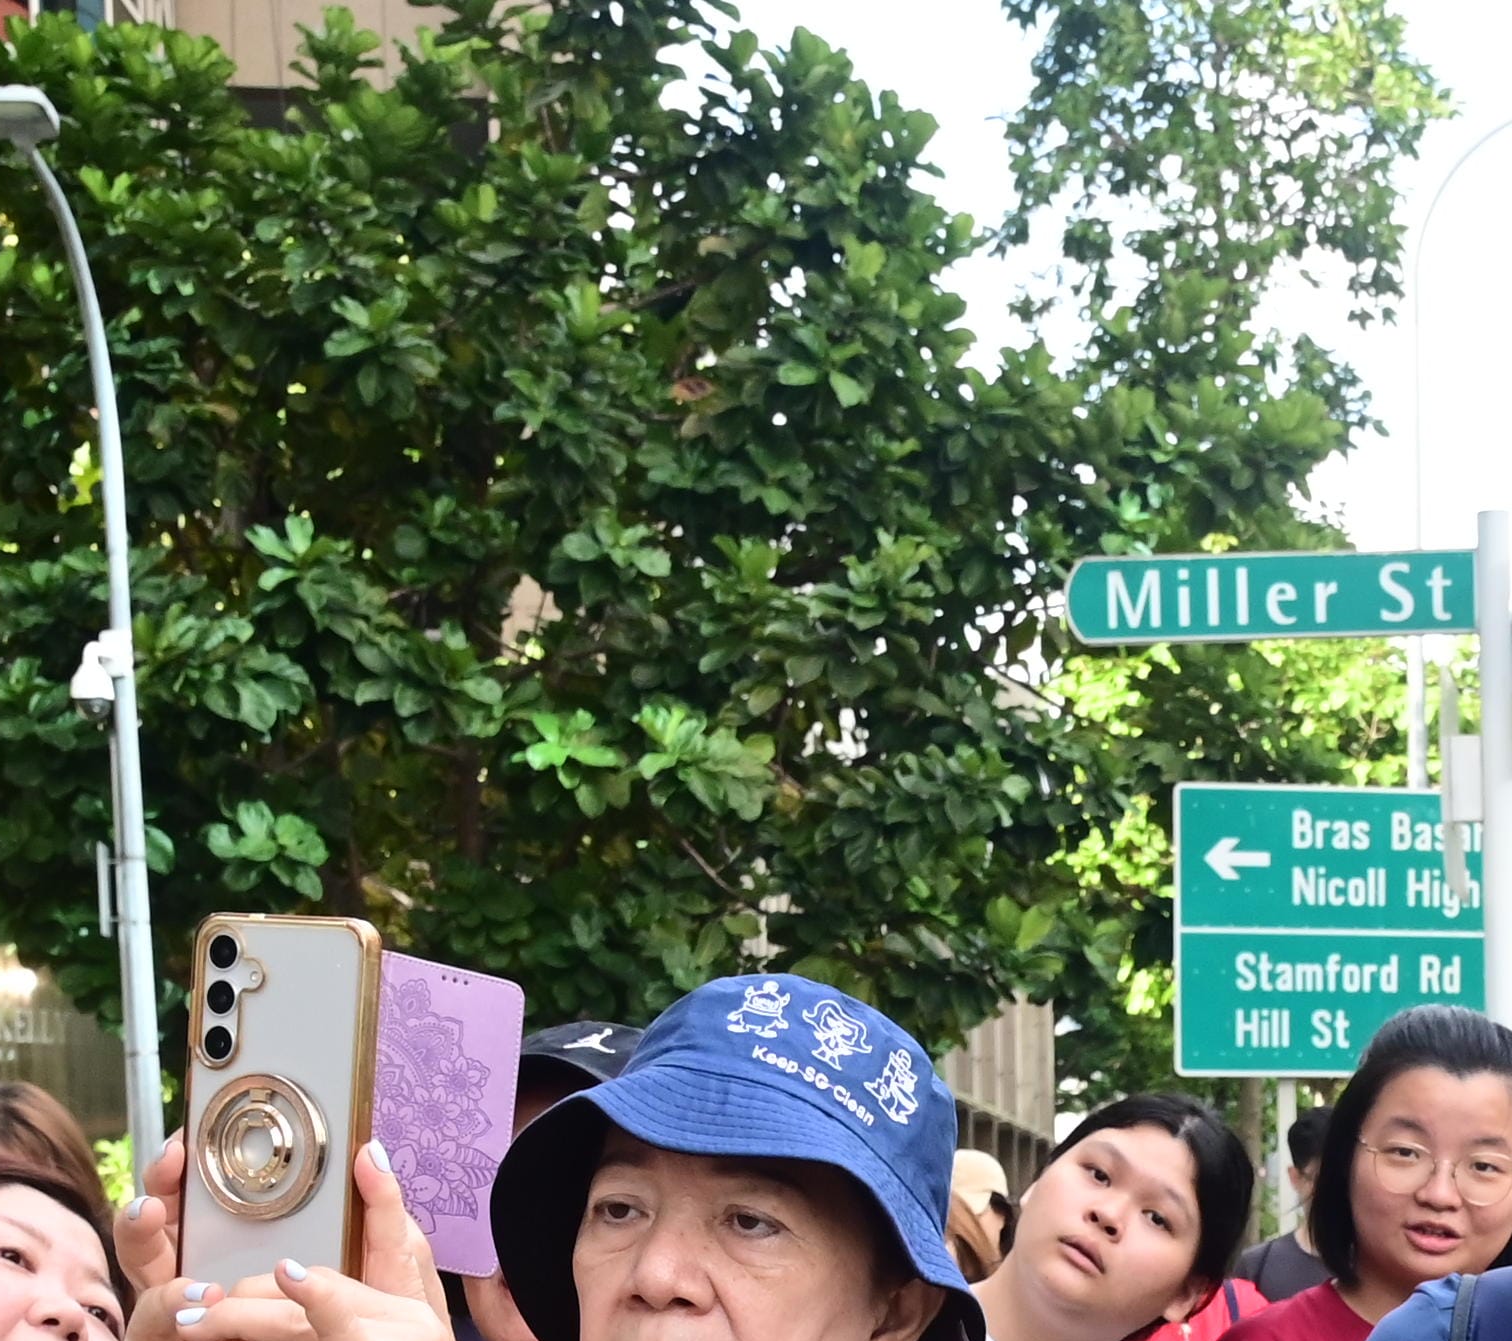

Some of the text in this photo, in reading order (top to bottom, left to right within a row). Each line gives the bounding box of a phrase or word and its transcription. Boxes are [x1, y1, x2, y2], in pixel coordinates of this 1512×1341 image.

[1106, 562, 1453, 629] Miller St
[1292, 809, 1370, 850] Bras
[1292, 866, 1386, 907] Nicoll
[1236, 952, 1461, 994] Stamford Rd
[1236, 1010, 1350, 1048] Hill St
[752, 1045, 874, 1126] Keep SG Clean
